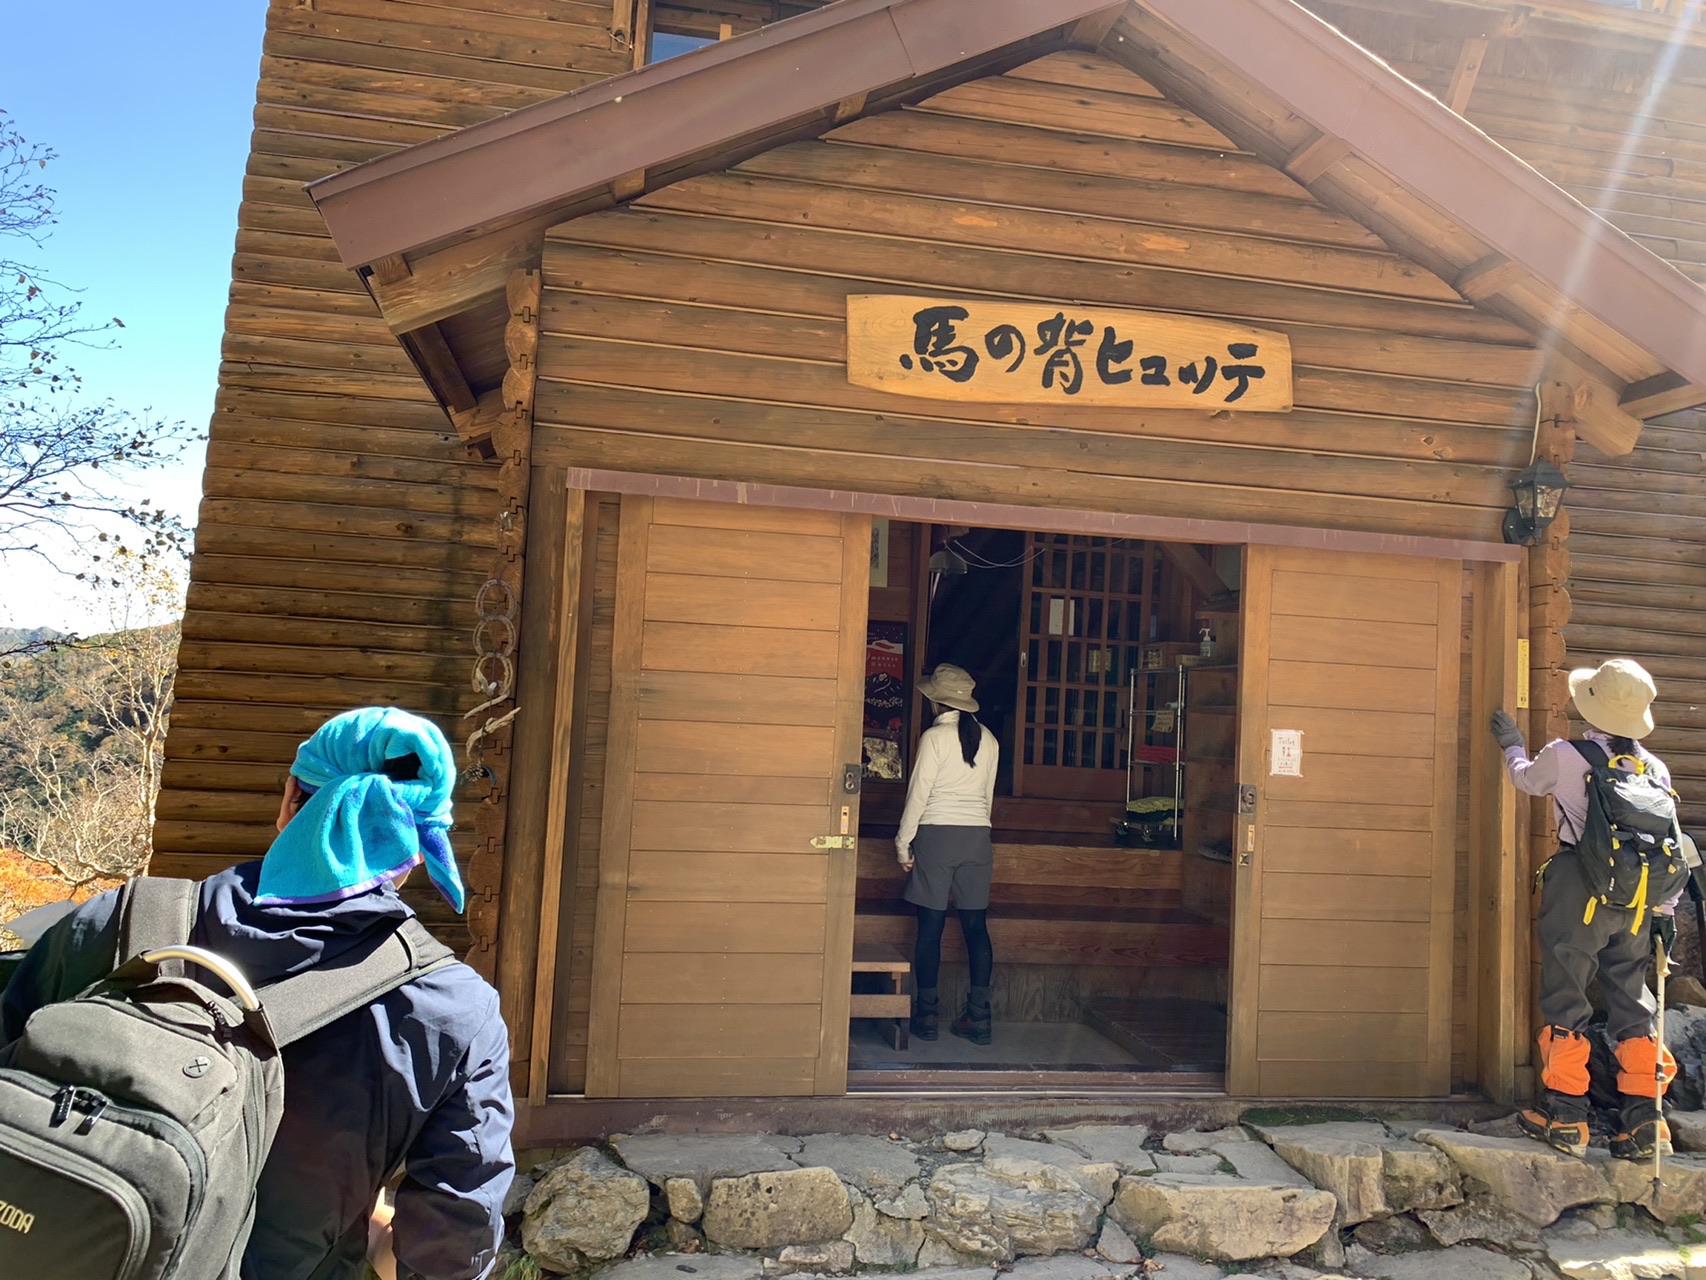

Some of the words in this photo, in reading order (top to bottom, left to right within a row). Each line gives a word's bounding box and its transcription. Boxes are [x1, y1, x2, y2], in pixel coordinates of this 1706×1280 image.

[900, 305, 1266, 402] 馬の背ヒュッテ
